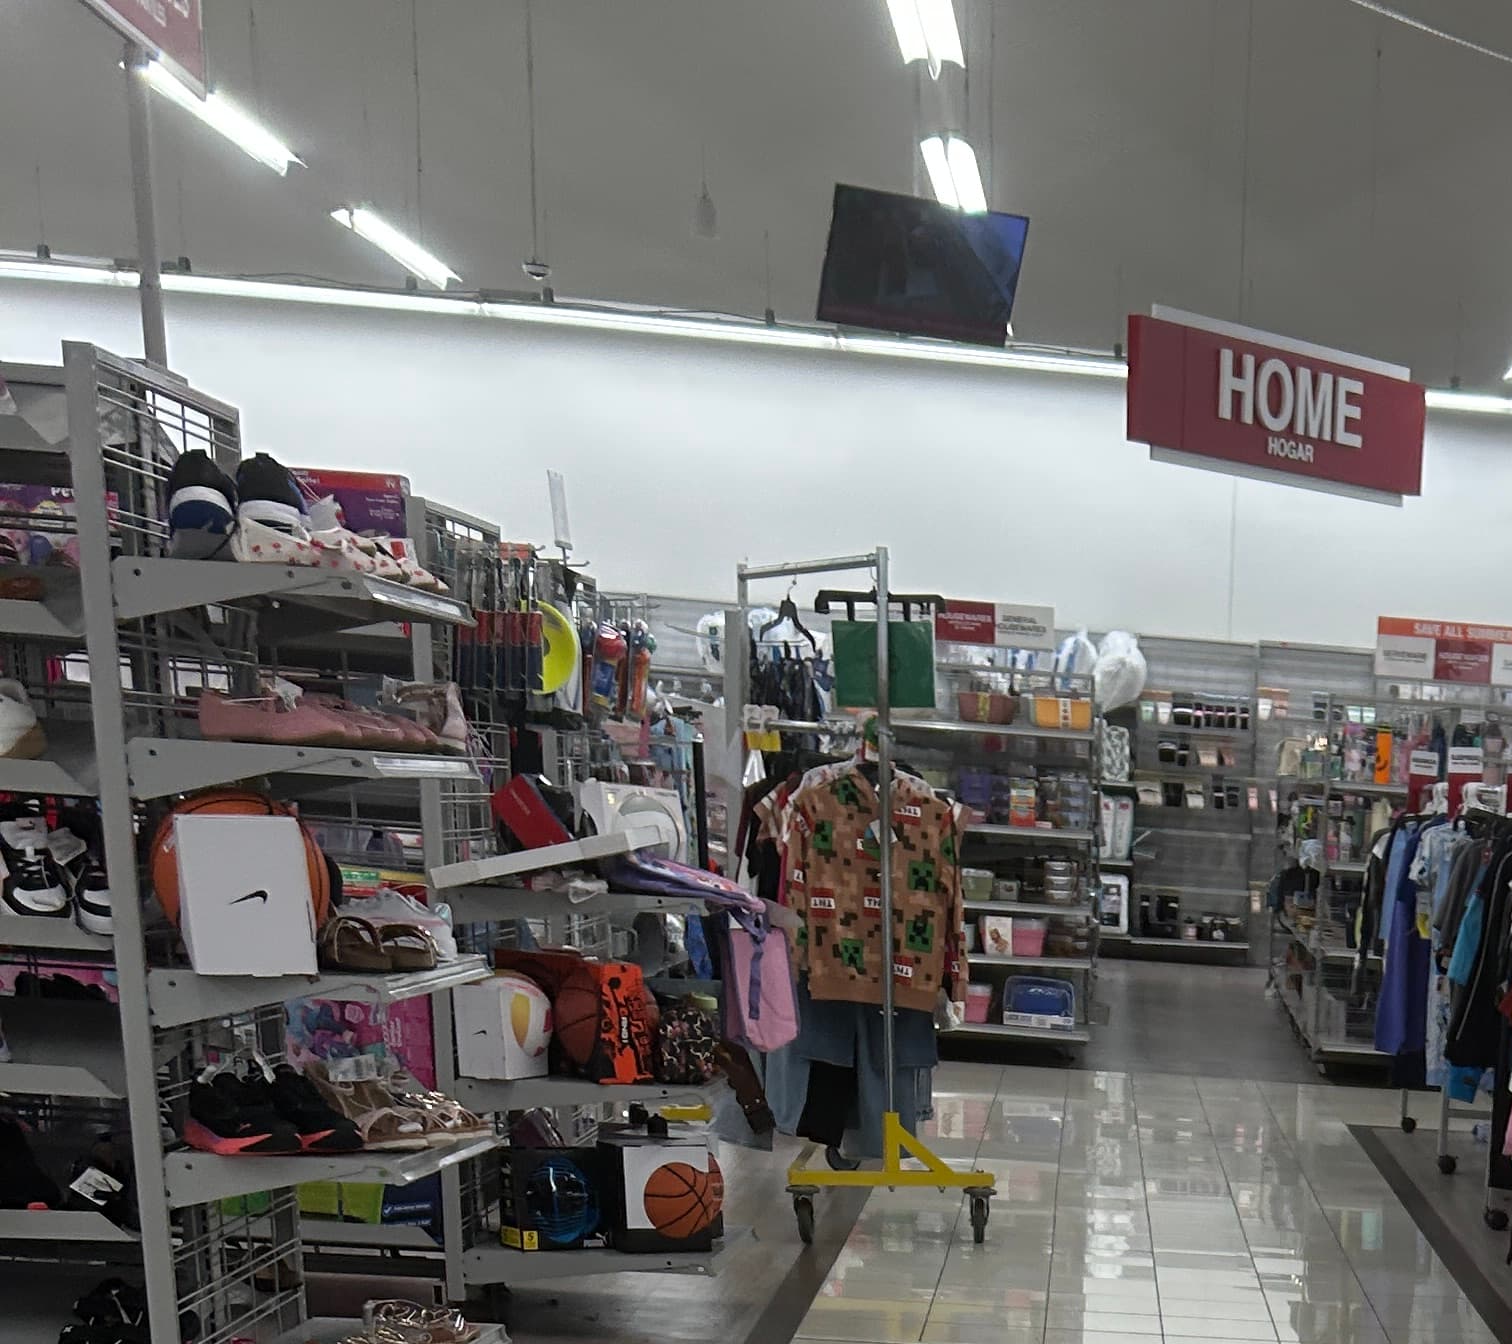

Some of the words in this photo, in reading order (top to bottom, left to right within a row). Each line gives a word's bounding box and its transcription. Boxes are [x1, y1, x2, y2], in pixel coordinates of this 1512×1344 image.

[1218, 348, 1364, 449] HOME
[1267, 436, 1314, 463] HOGAR
[1413, 622, 1441, 637] SAVE
[1443, 624, 1464, 638] ALL
